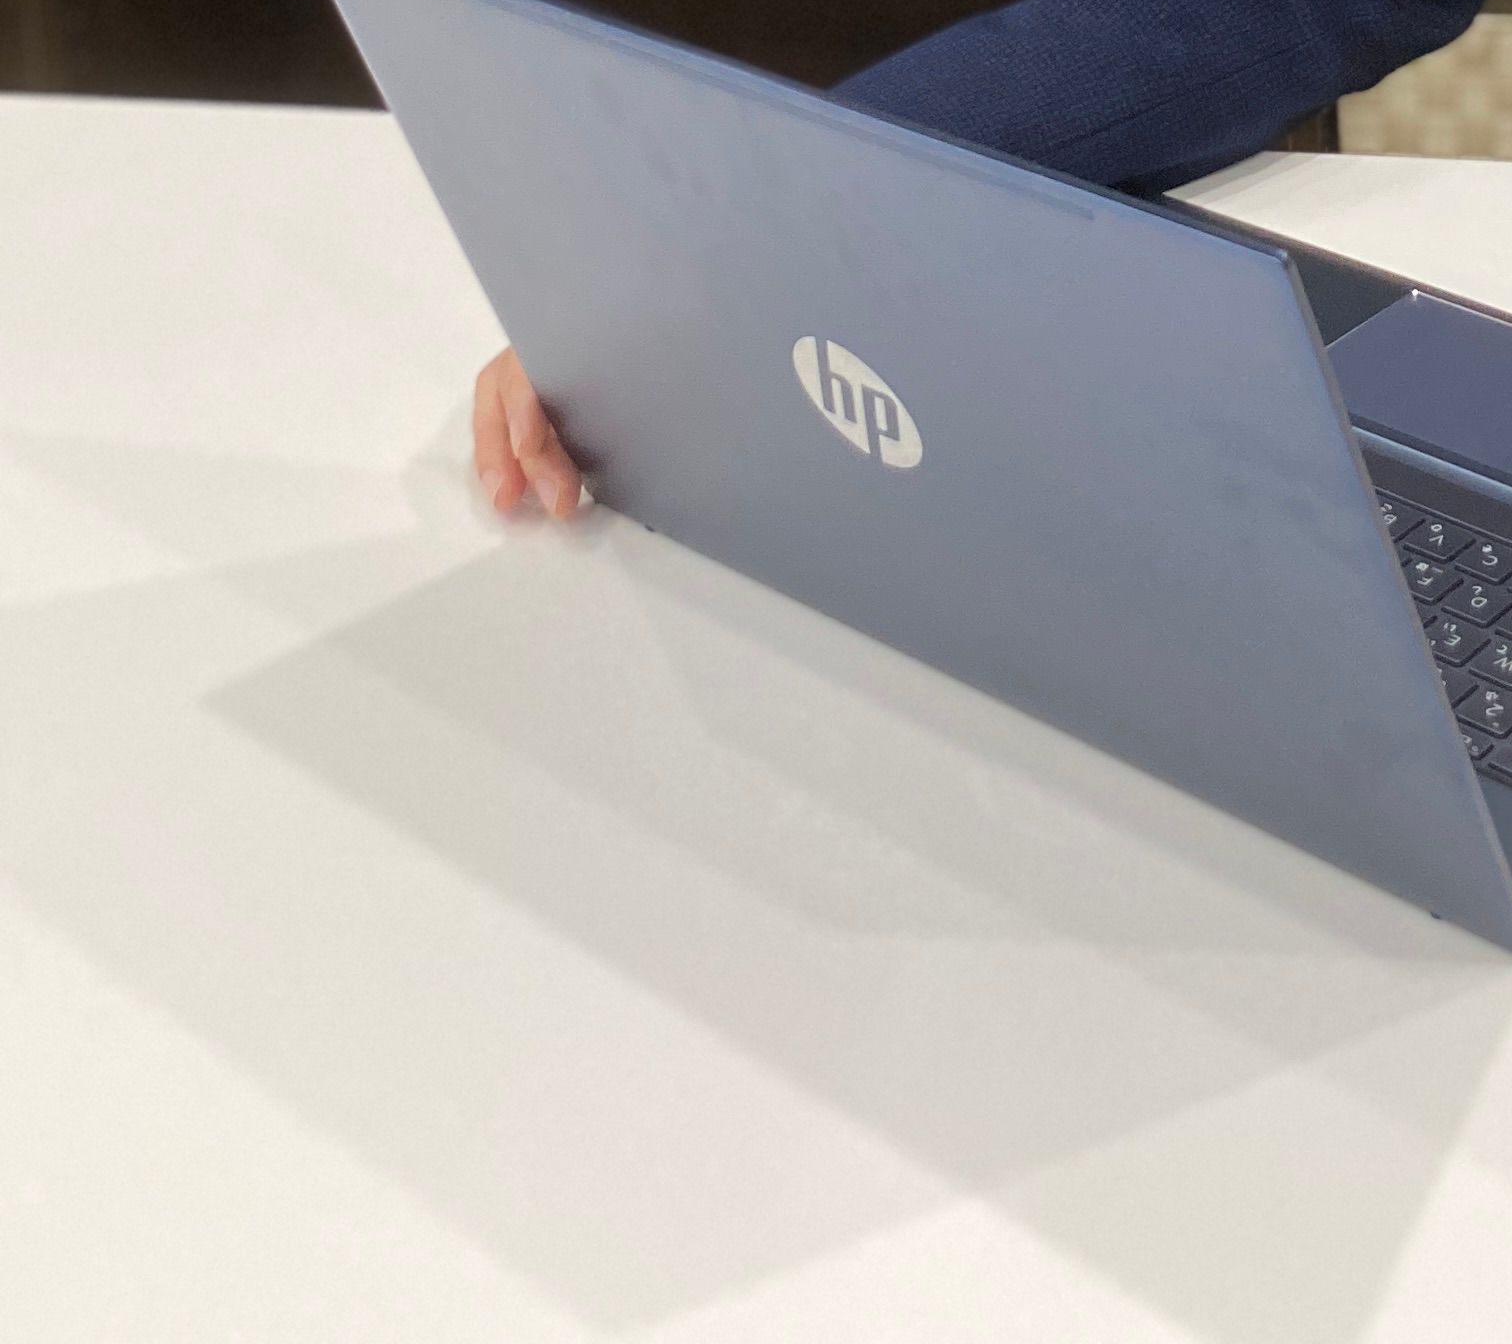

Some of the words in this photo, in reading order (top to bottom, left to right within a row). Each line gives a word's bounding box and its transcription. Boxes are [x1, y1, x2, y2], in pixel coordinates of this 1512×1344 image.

[812, 336, 902, 463] hp
[1428, 534, 1444, 547] V
[1482, 555, 1498, 566] C
[1416, 576, 1434, 587] F
[1470, 597, 1488, 608] D
[1443, 634, 1462, 646] E
[1485, 703, 1504, 716] 2
